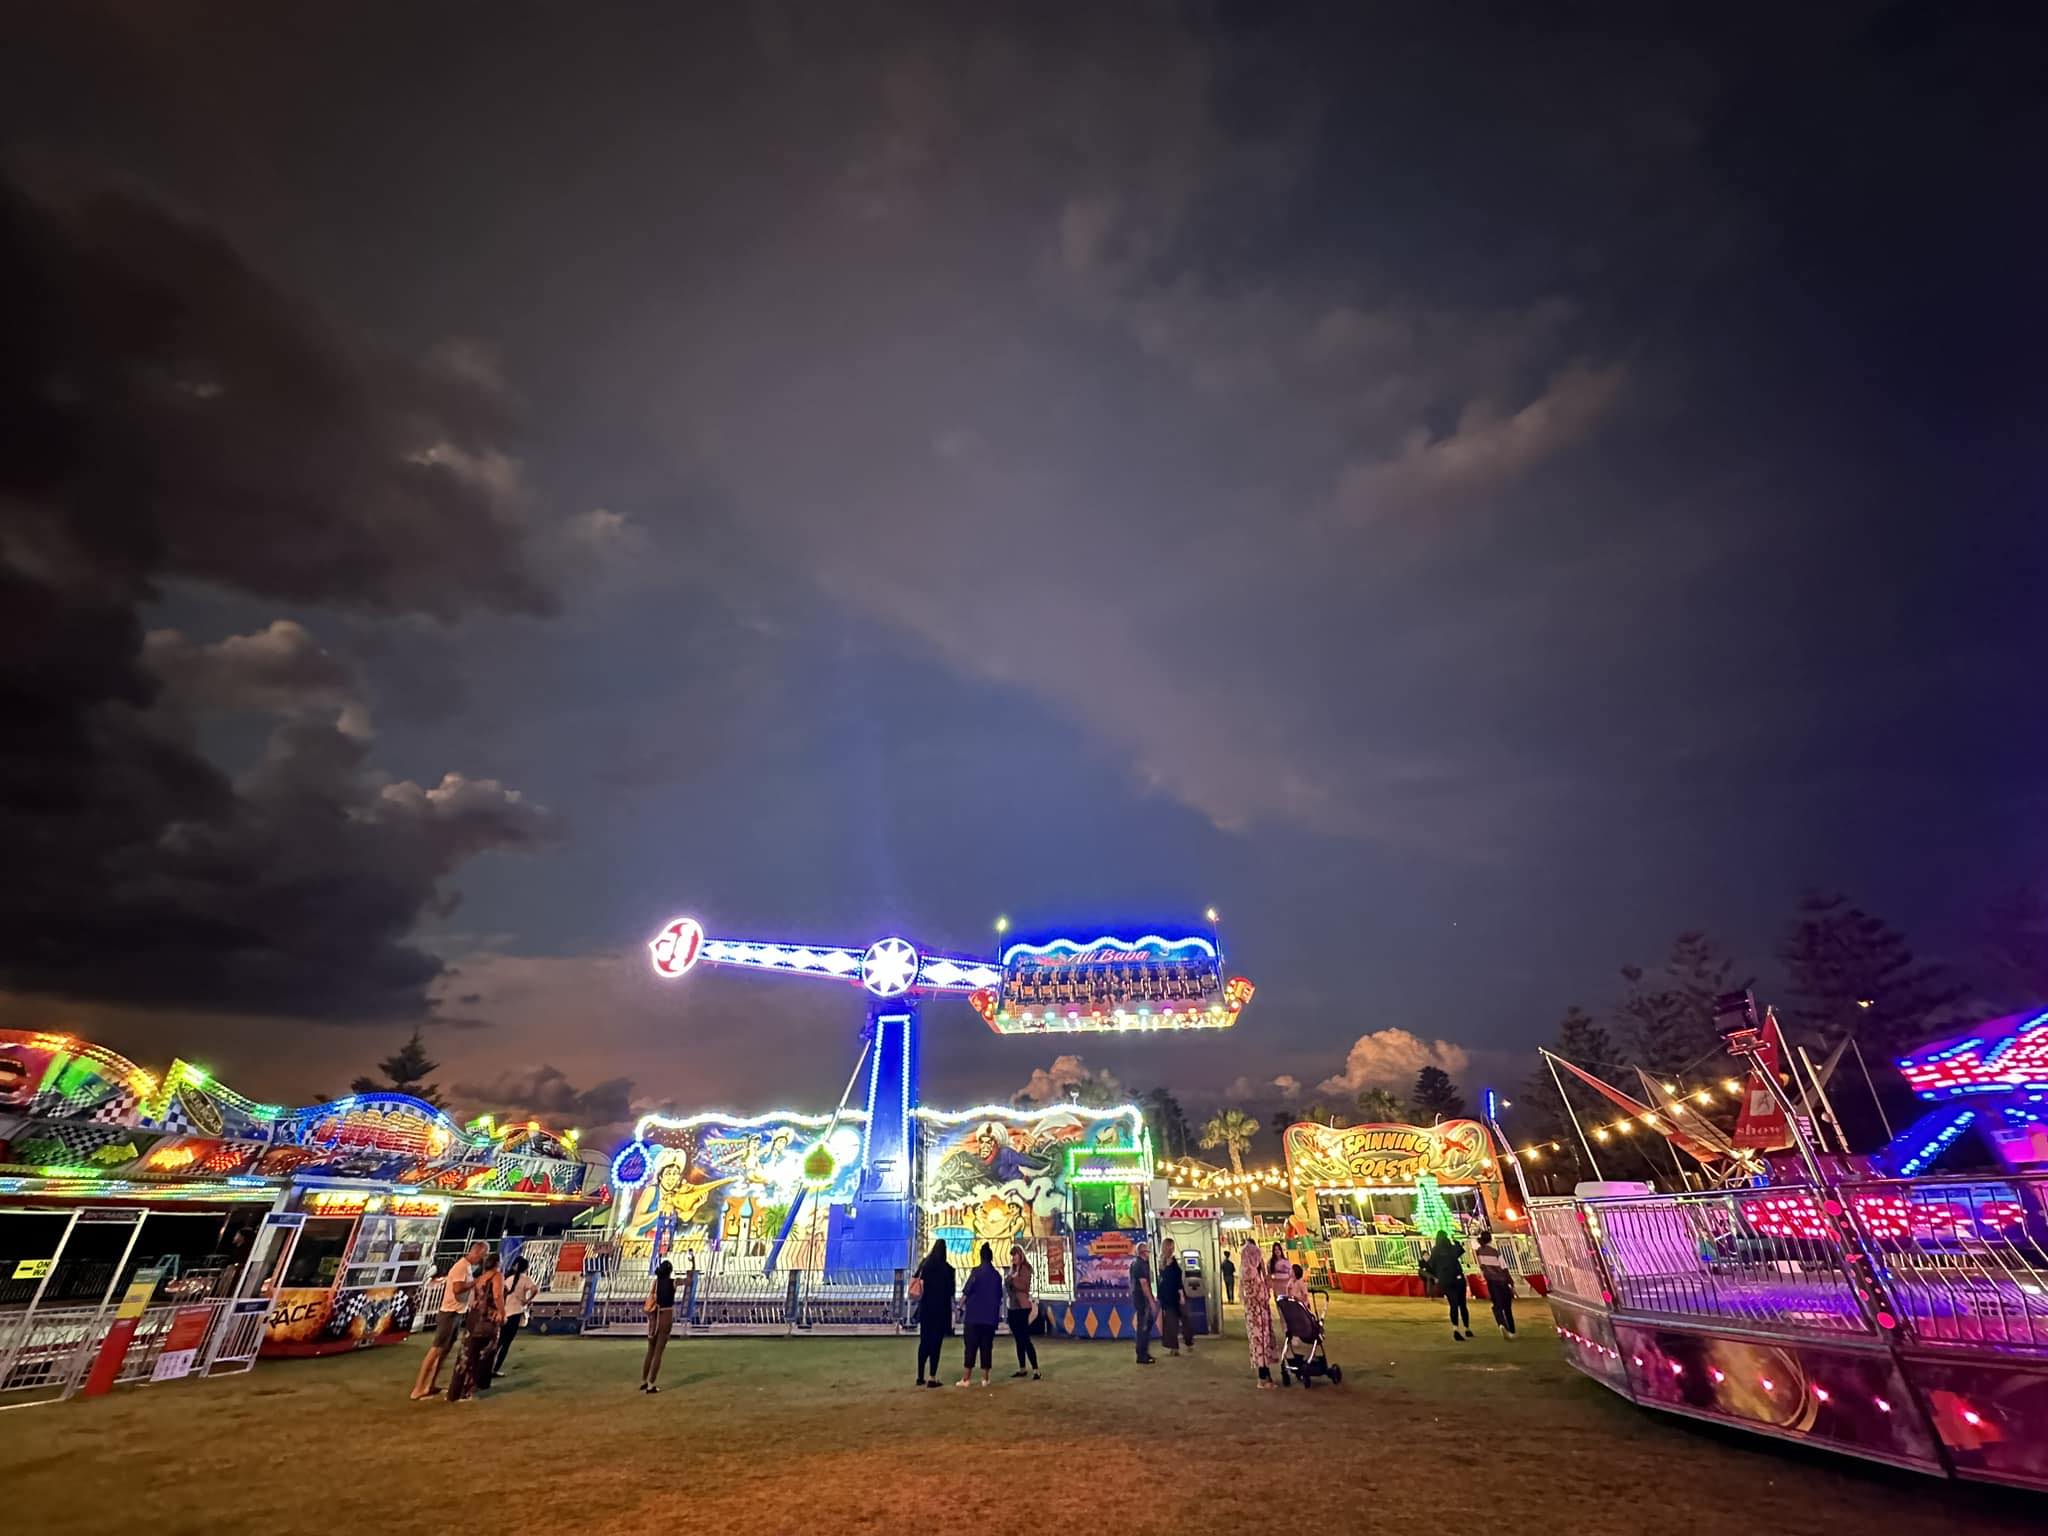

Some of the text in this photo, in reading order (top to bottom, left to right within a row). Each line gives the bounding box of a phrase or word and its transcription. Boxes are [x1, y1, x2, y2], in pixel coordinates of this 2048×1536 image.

[1736, 1123, 1780, 1136] show
[1344, 1131, 1431, 1156] SPINNING
[1350, 1153, 1430, 1178] COASTER
[1169, 1208, 1209, 1218] ATM
[263, 1301, 322, 1328] RACE
